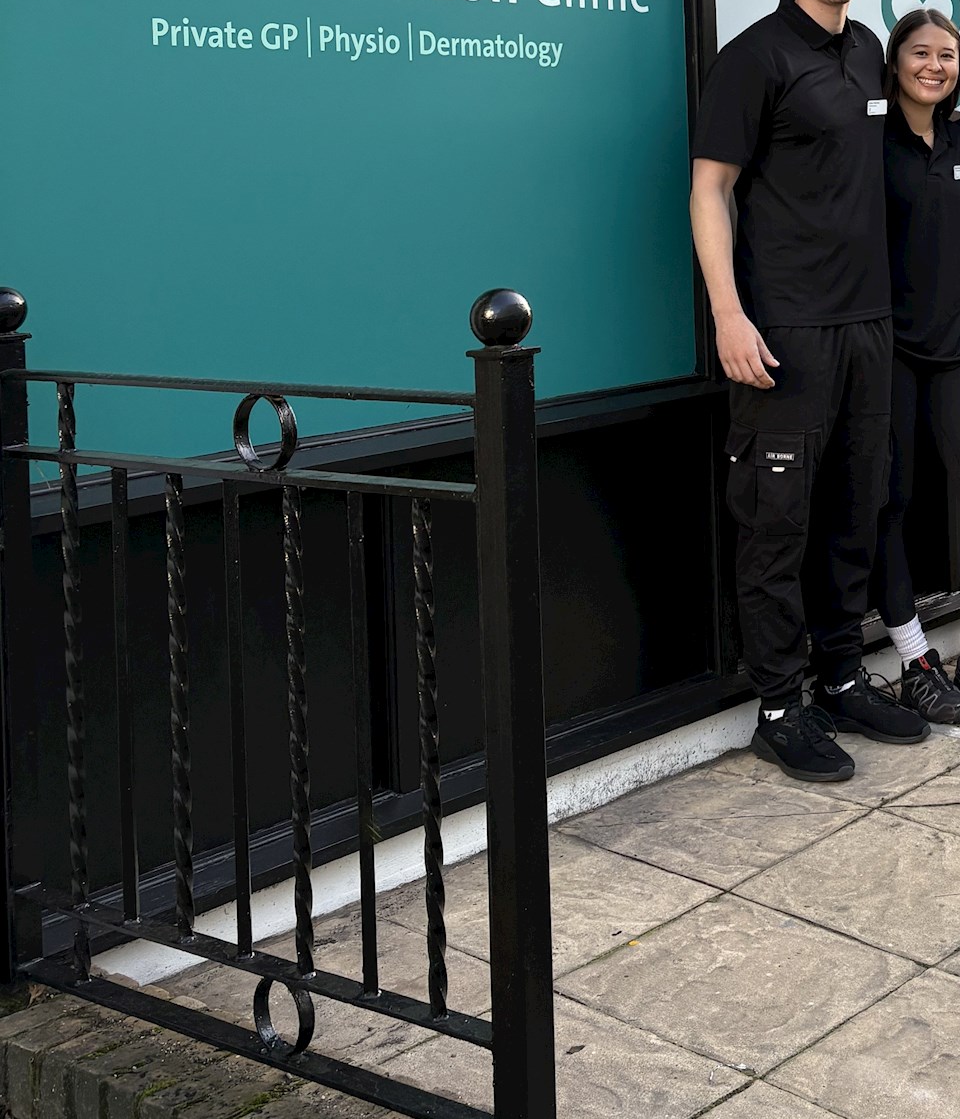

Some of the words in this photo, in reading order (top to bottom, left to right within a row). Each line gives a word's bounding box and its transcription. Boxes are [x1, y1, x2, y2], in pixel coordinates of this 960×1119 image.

[152, 18, 253, 49] Private
[261, 23, 298, 50] GP
[319, 24, 400, 61] Physio
[419, 31, 563, 67] Dermatology
